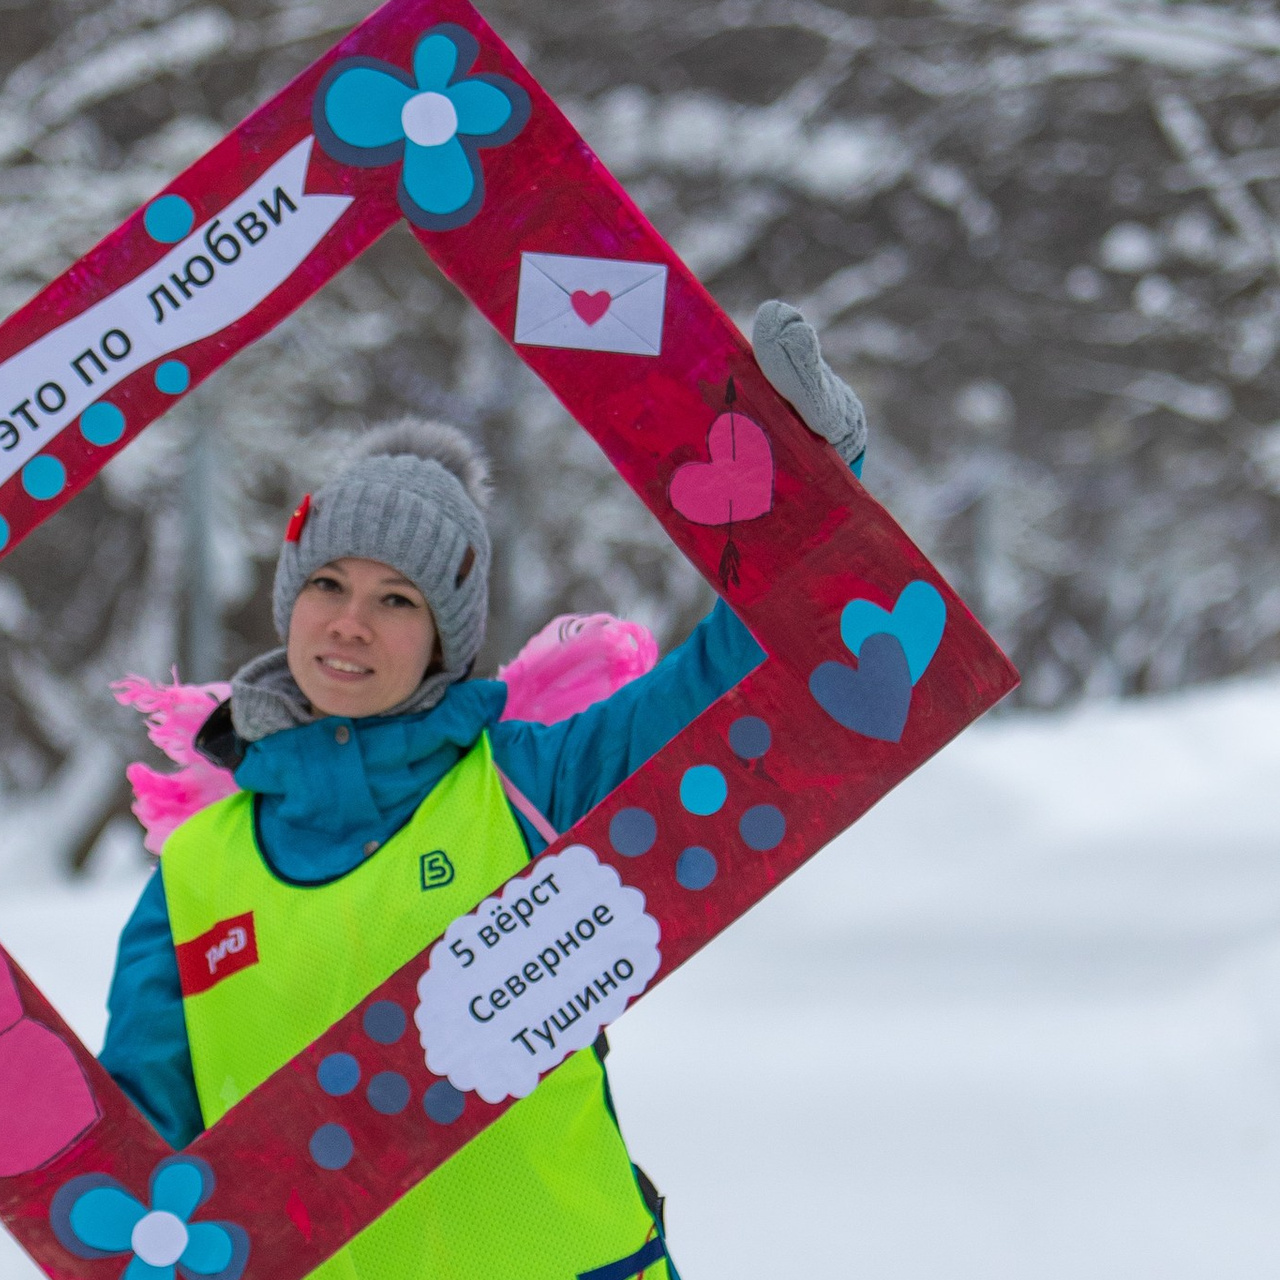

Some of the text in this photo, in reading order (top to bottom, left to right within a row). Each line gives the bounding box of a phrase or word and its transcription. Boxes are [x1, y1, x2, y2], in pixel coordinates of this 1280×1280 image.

[70, 329, 132, 386] по
[146, 185, 299, 324] любви
[448, 873, 561, 969] 5 вёрст
[469, 904, 614, 1024] Северное
[511, 958, 635, 1056] Тушино
